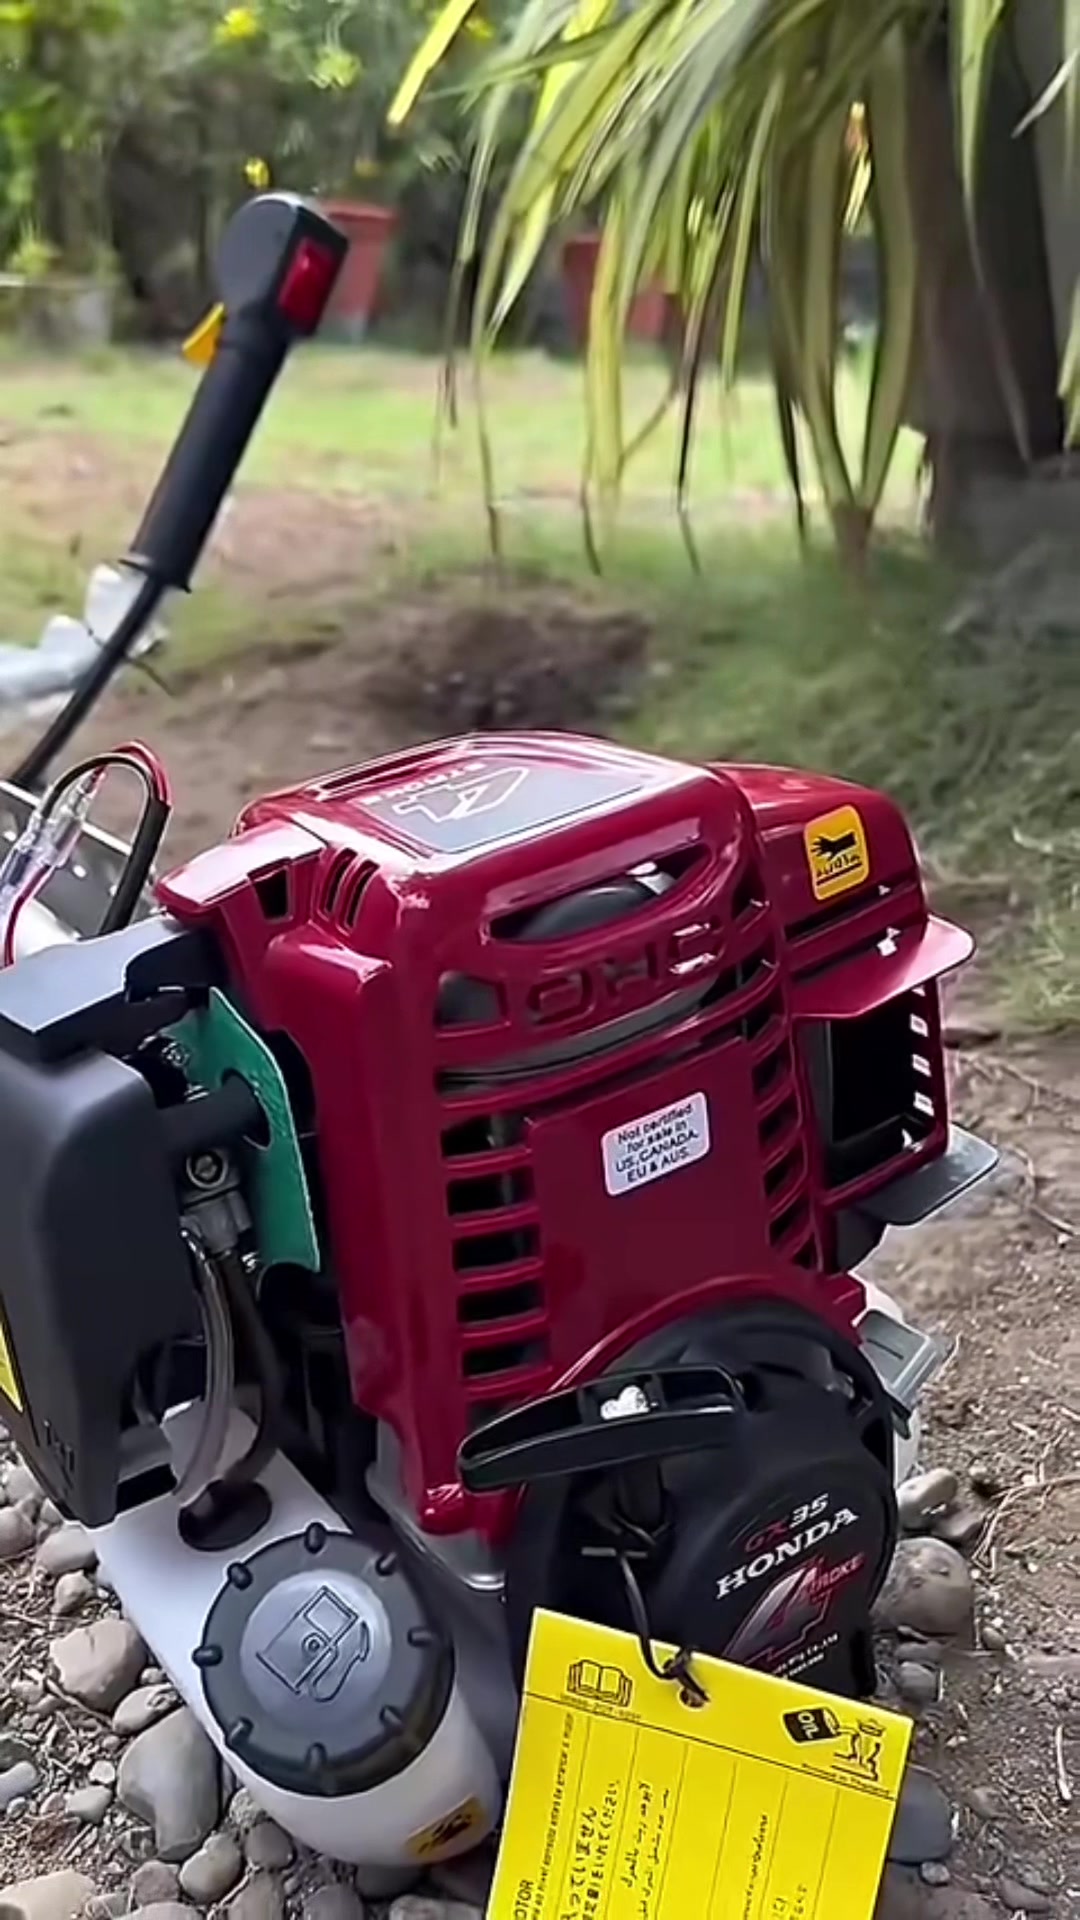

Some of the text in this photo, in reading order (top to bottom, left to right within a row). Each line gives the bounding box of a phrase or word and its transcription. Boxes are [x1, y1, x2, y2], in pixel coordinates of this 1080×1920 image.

[627, 1164, 647, 1183] EU
[716, 1507, 860, 1600] HONDA
[797, 1710, 821, 1740] OIL
